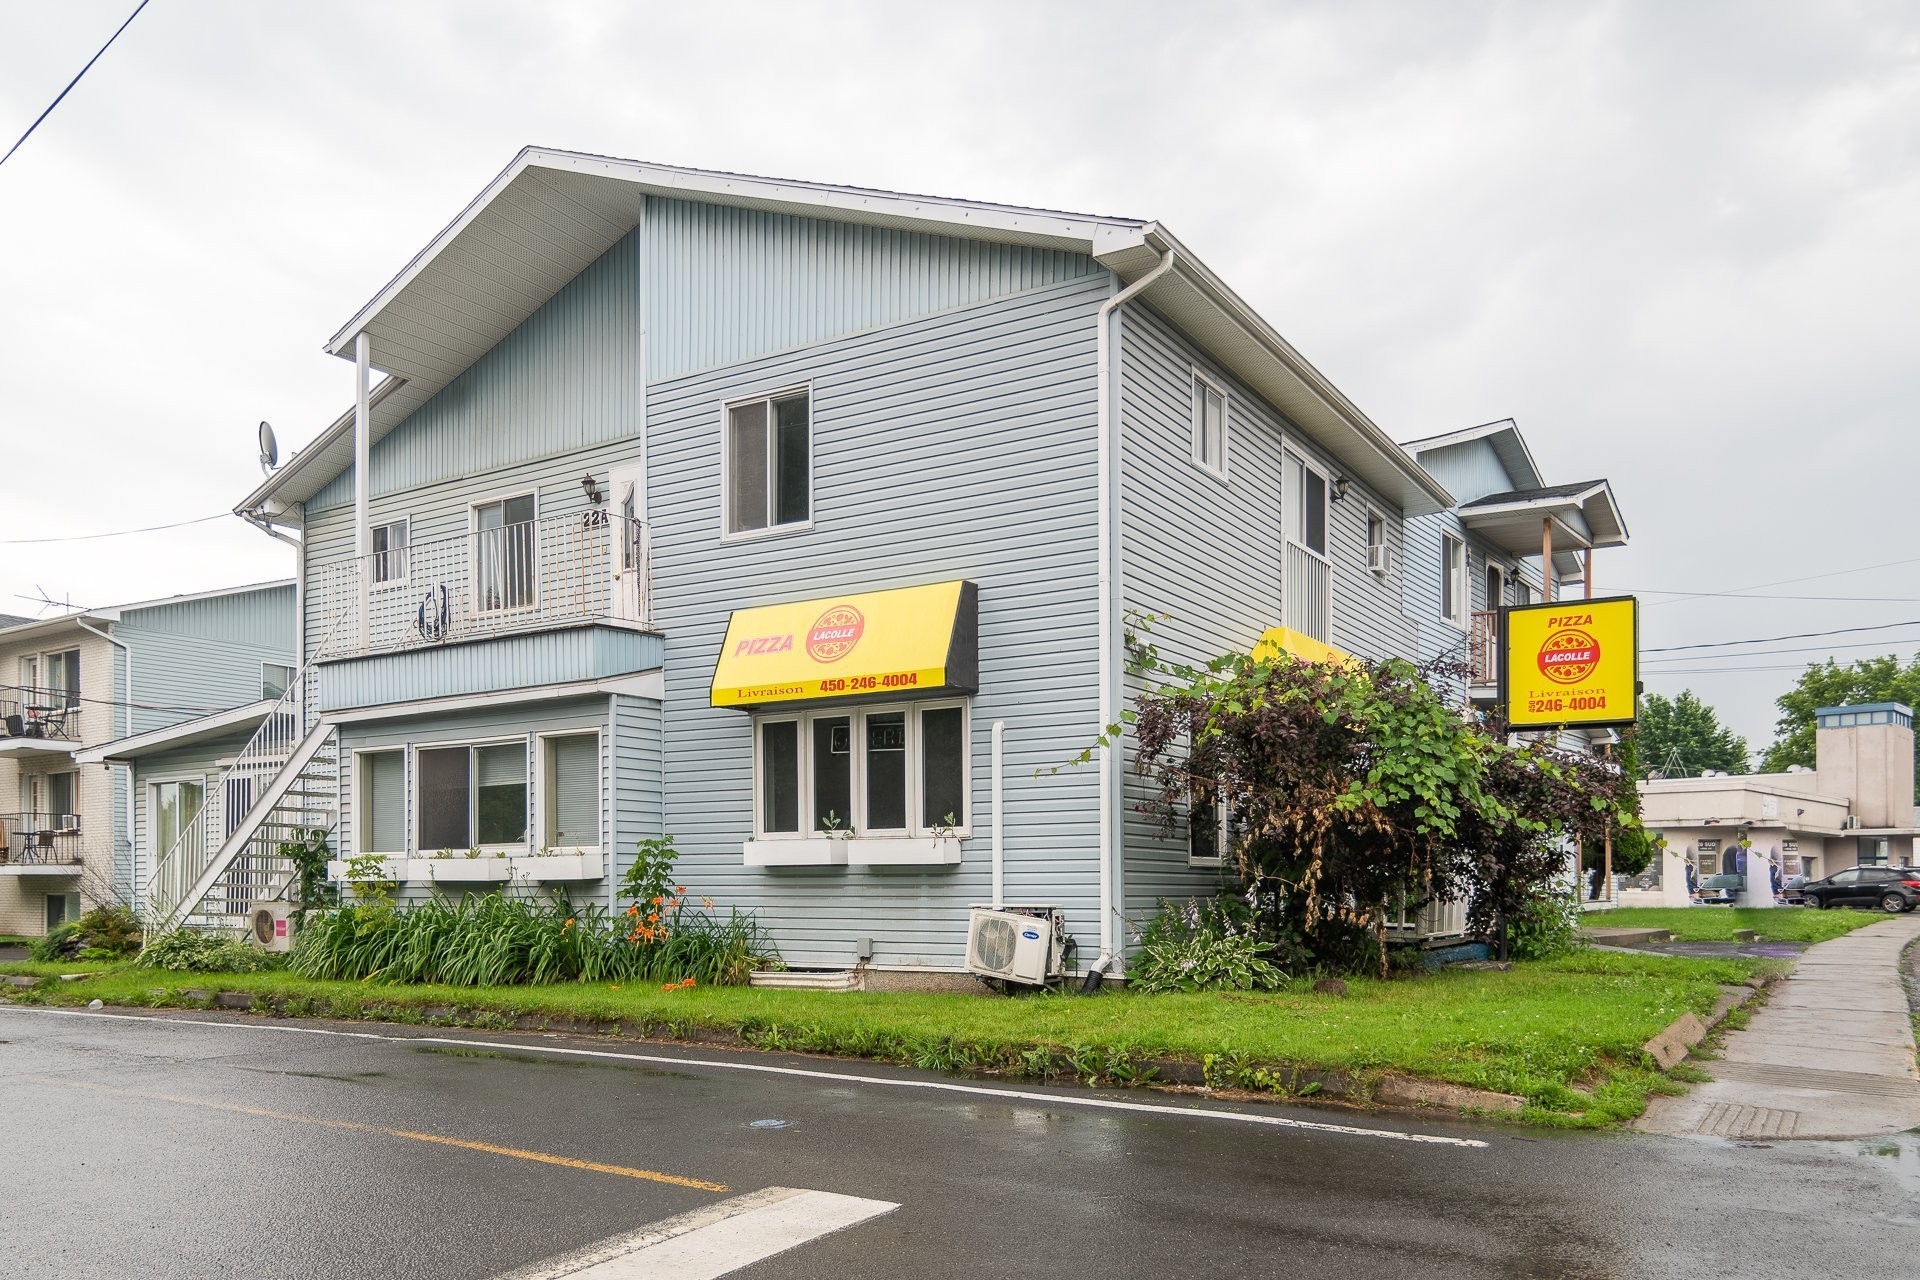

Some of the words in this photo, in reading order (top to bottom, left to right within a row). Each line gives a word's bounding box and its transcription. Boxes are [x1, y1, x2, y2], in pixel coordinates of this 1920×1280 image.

[583, 509, 609, 527] 22A
[1548, 614, 1593, 628] PIZZA
[813, 627, 855, 641] LACOLLE
[734, 634, 794, 657] PIZZA
[1544, 651, 1591, 663] LACOLLE
[737, 686, 804, 698] Livraison
[819, 673, 918, 692] 450-246-4004
[1528, 688, 1606, 698] Livraison
[1528, 700, 1536, 713] 450
[1535, 696, 1606, 714] 246-4004
